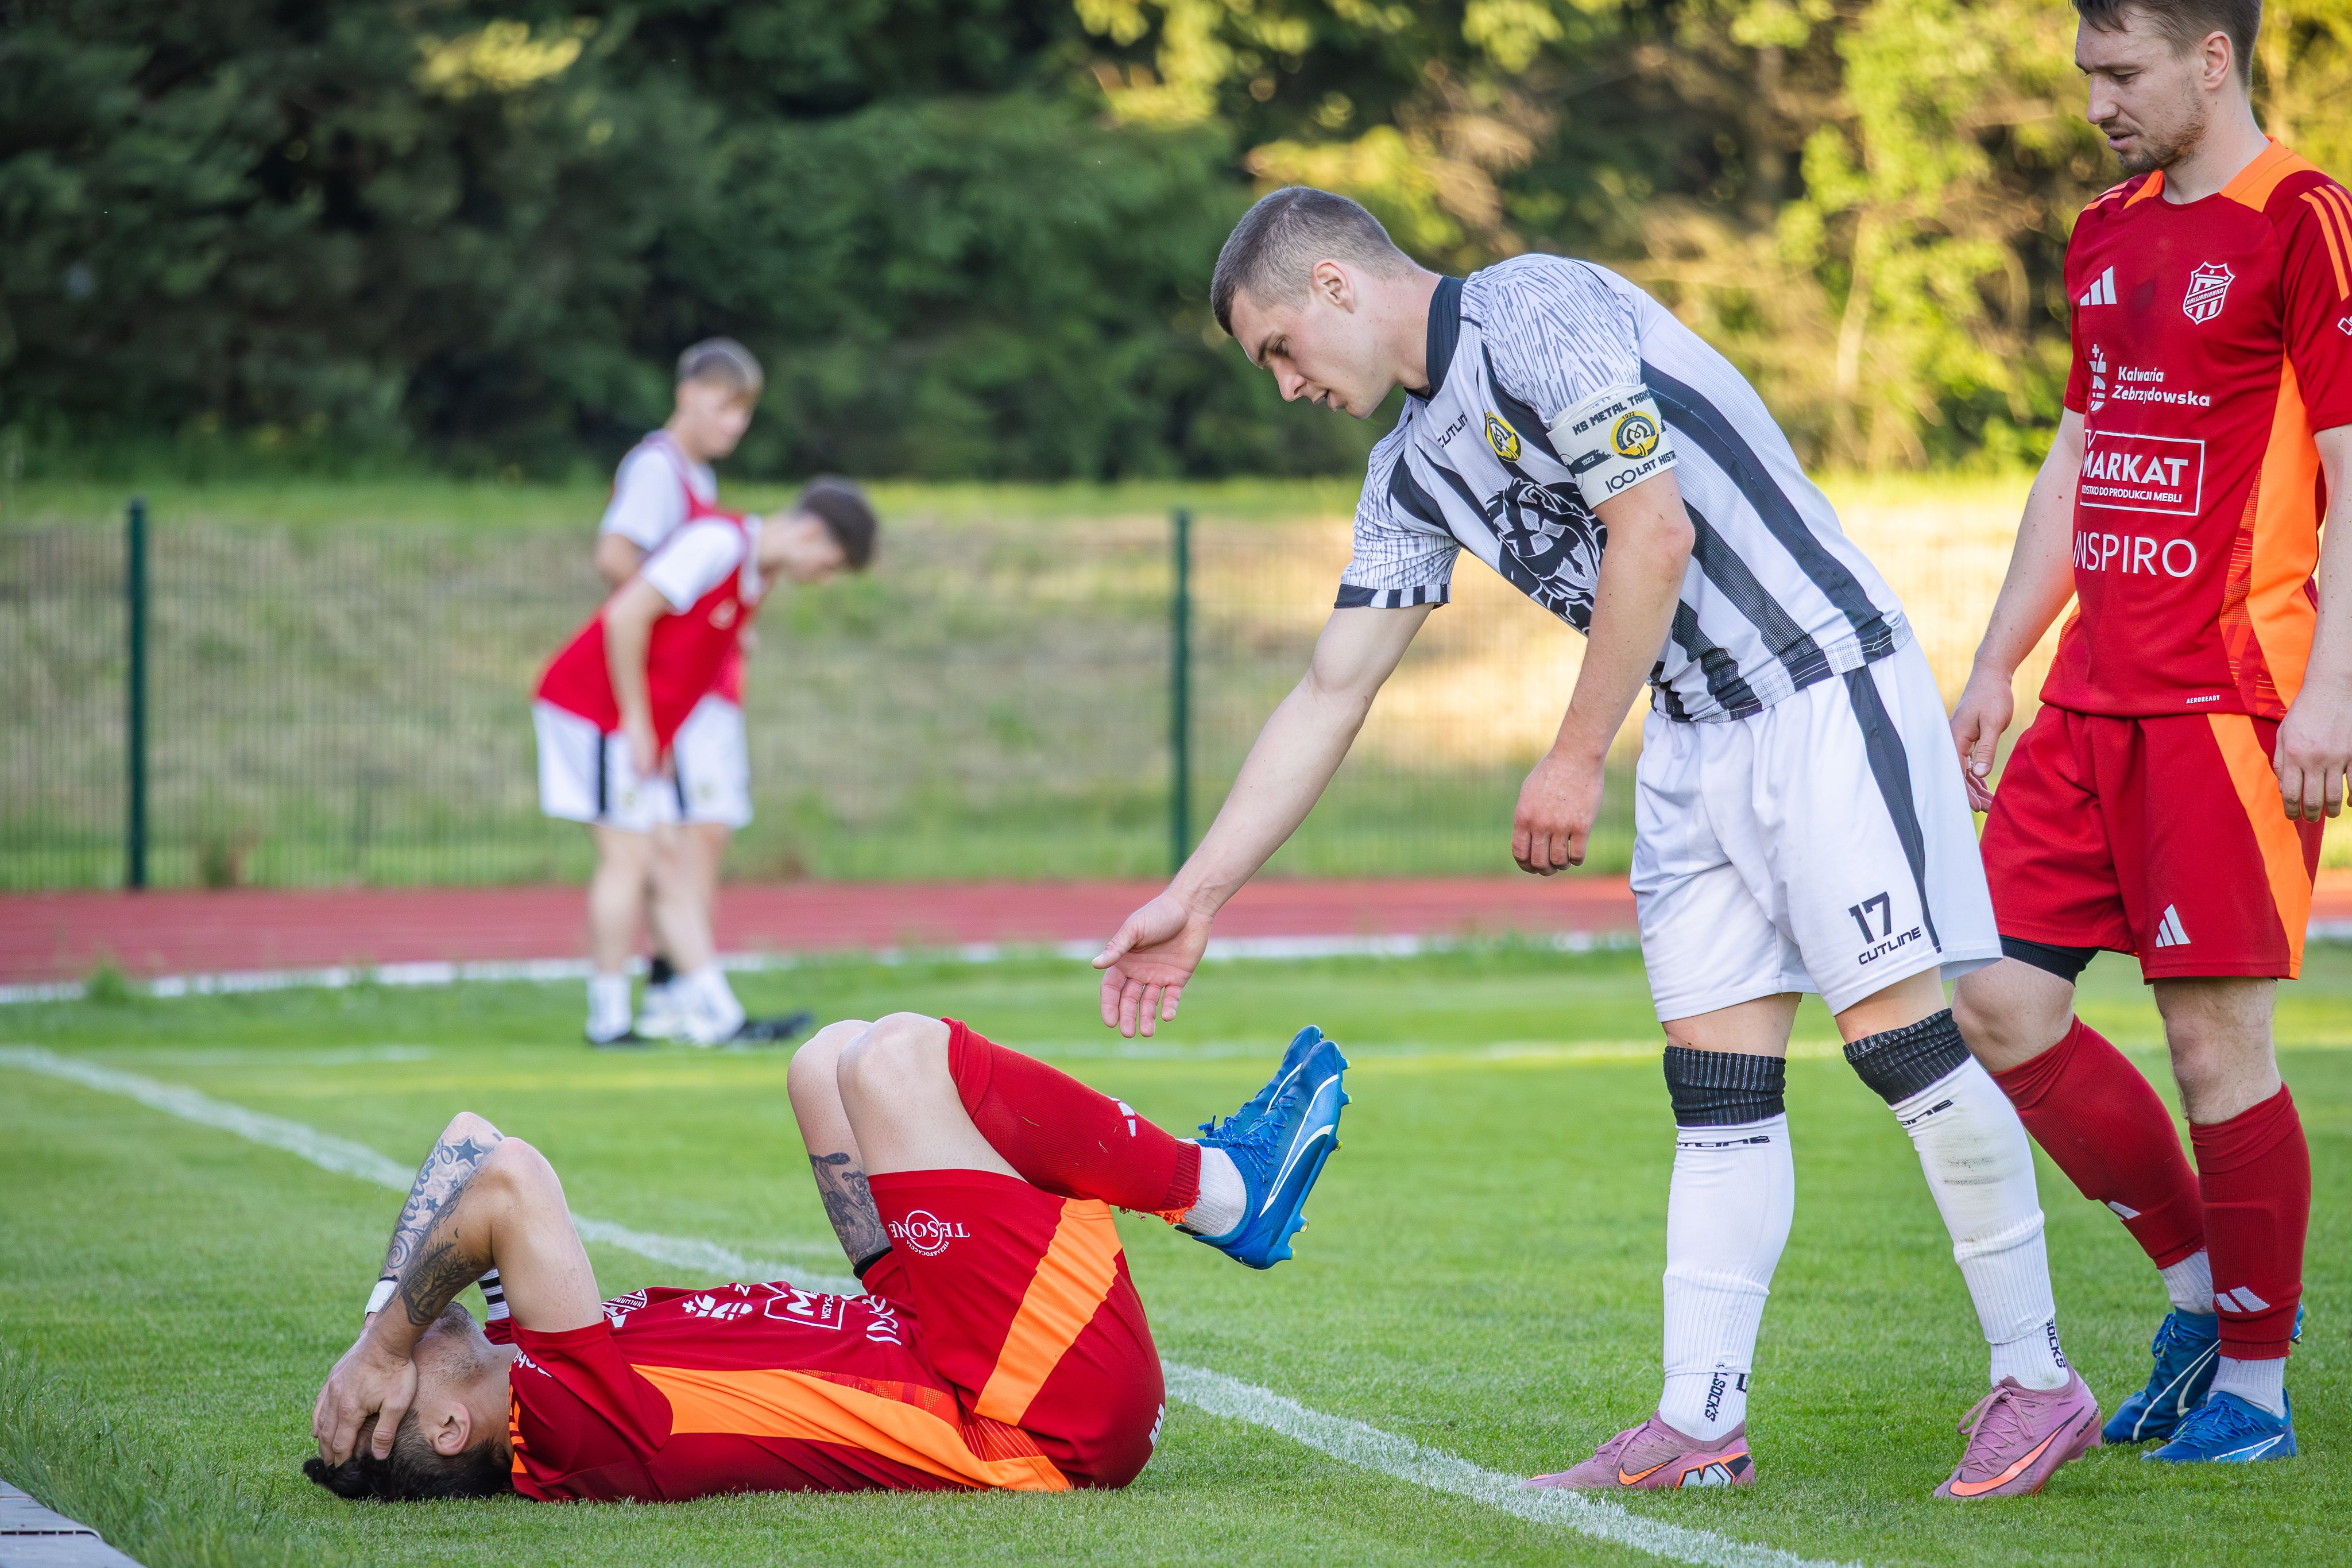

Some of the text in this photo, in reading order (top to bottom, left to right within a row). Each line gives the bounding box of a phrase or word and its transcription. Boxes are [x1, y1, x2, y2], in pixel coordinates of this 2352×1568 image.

[2118, 366, 2164, 382] Kalwaria
[2111, 385, 2210, 406] Zebrzydowska
[1572, 421, 1589, 436] KS
[1589, 402, 1627, 427] METAL
[1581, 455, 1596, 466] 1922
[1635, 459, 1657, 476] LAT
[2082, 450, 2189, 487] MARKAT
[2099, 486, 2109, 496] DO
[2109, 487, 2152, 501] PRODUKCJI
[2153, 492, 2182, 503] MEBLI
[2185, 695, 2221, 704] AEROREADY
[1848, 891, 1892, 944] 17
[1858, 926, 1921, 965] CUTLINE
[888, 1221, 970, 1240] TESONE
